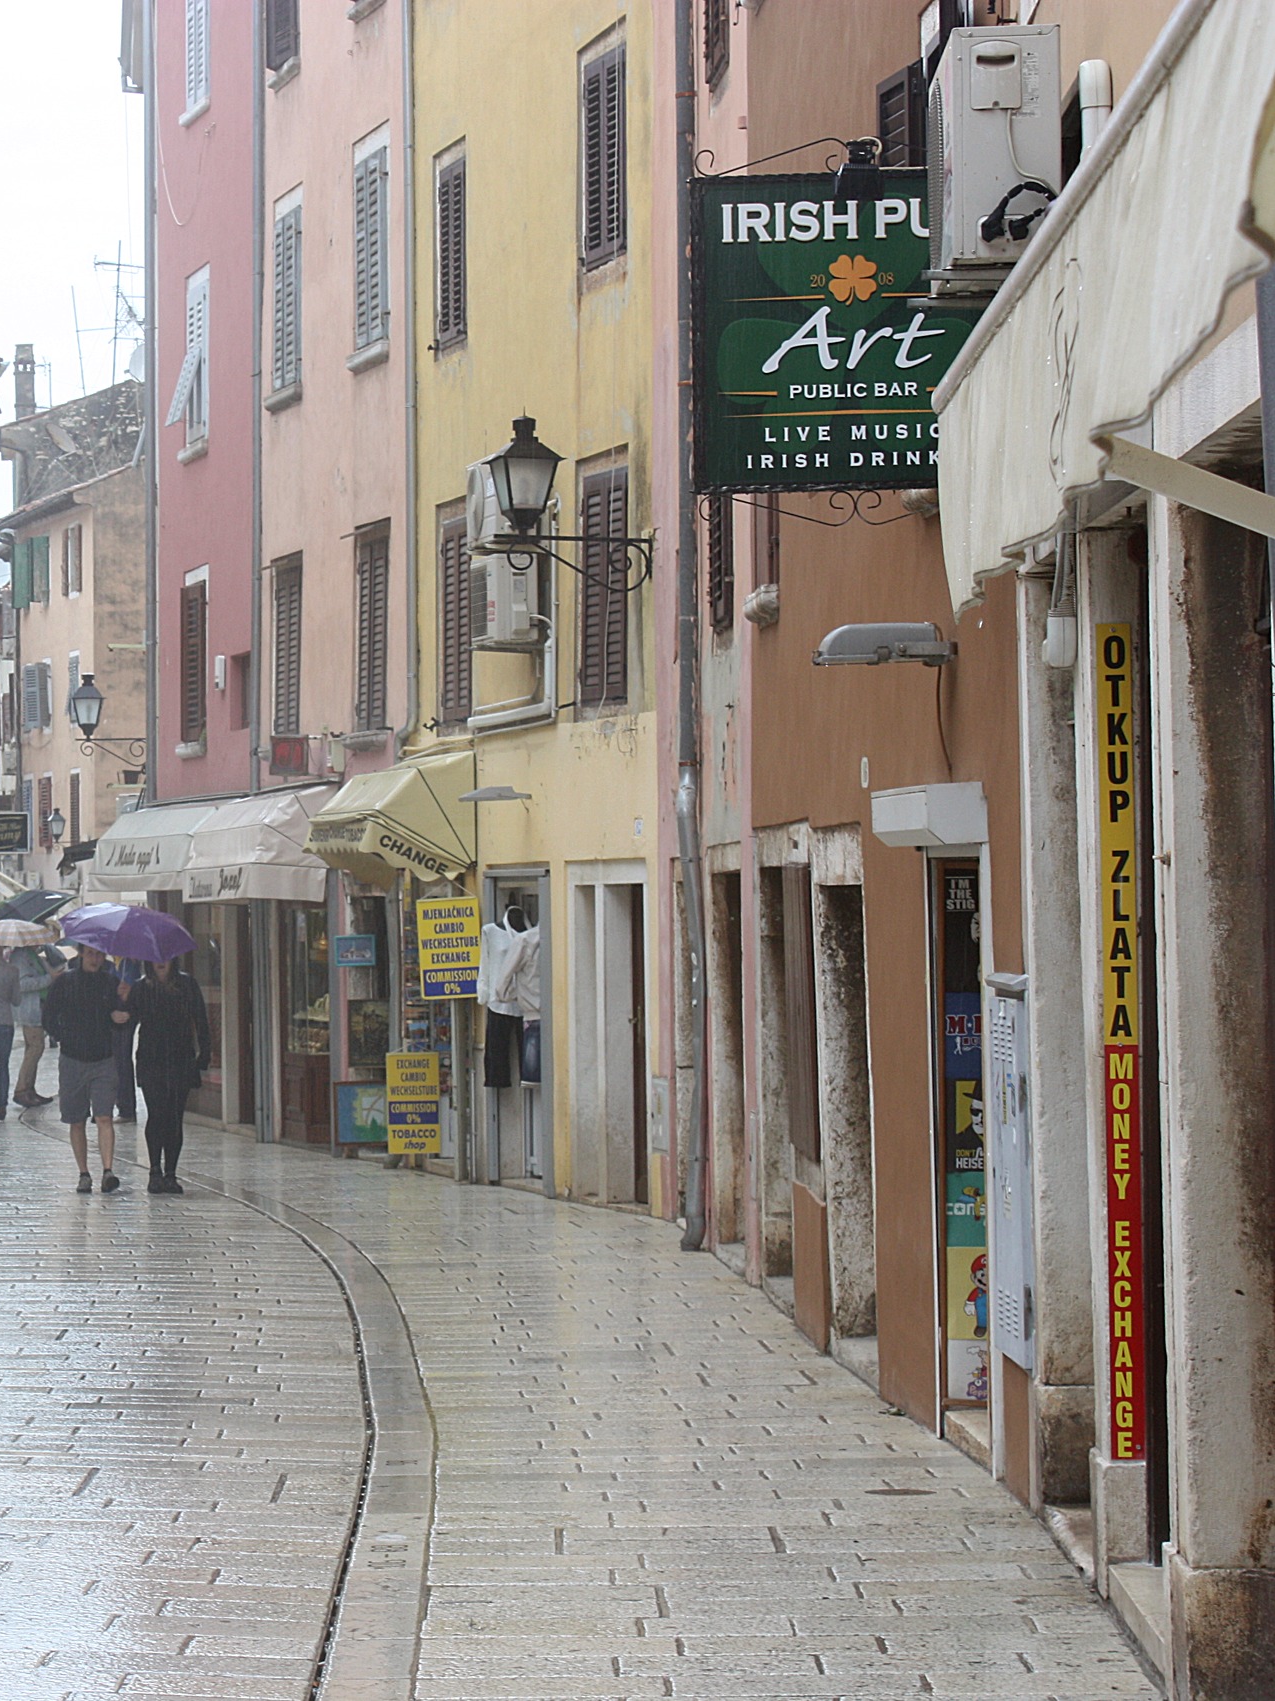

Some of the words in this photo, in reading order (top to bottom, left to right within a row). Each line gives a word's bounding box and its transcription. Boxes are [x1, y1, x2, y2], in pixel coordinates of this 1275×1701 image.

[721, 200, 859, 243] IRISH
[810, 274, 826, 288] 20
[878, 272, 894, 286] 08
[761, 305, 946, 374] Art
[789, 383, 868, 400] PUBLIC
[874, 382, 919, 398] BAR
[764, 426, 832, 443] LIVE
[850, 423, 940, 441] MUSIC
[747, 453, 830, 469] IRISH
[849, 451, 939, 468] DRINK
[1103, 635, 1130, 823] OTKUP
[379, 834, 449, 875] CHANGE
[950, 879, 970, 889] I'M
[948, 889, 973, 899] THE
[946, 899, 976, 910] STIG
[422, 906, 474, 920] MJENJAČNICA
[434, 922, 464, 934] CAMBIO
[421, 936, 479, 950] WECHSELSTUBE
[1109, 850, 1133, 1038] ZLATA
[431, 951, 471, 964] EXCHANGE
[426, 969, 479, 983] COMMISSION
[444, 983, 461, 994] 0%
[396, 1059, 430, 1069] EXCHANGE
[400, 1072, 426, 1082] CAMBIO
[390, 1085, 438, 1096] WECHSELSTUBE
[390, 1103, 437, 1114] COMMISSION
[406, 1113, 421, 1124] 0%
[1109, 1053, 1134, 1200] MONEY
[391, 1129, 437, 1139] TOBACCO
[404, 1140, 426, 1151] shop
[955, 1149, 975, 1157] DON'T
[1113, 1220, 1134, 1458] EXCHANGE
